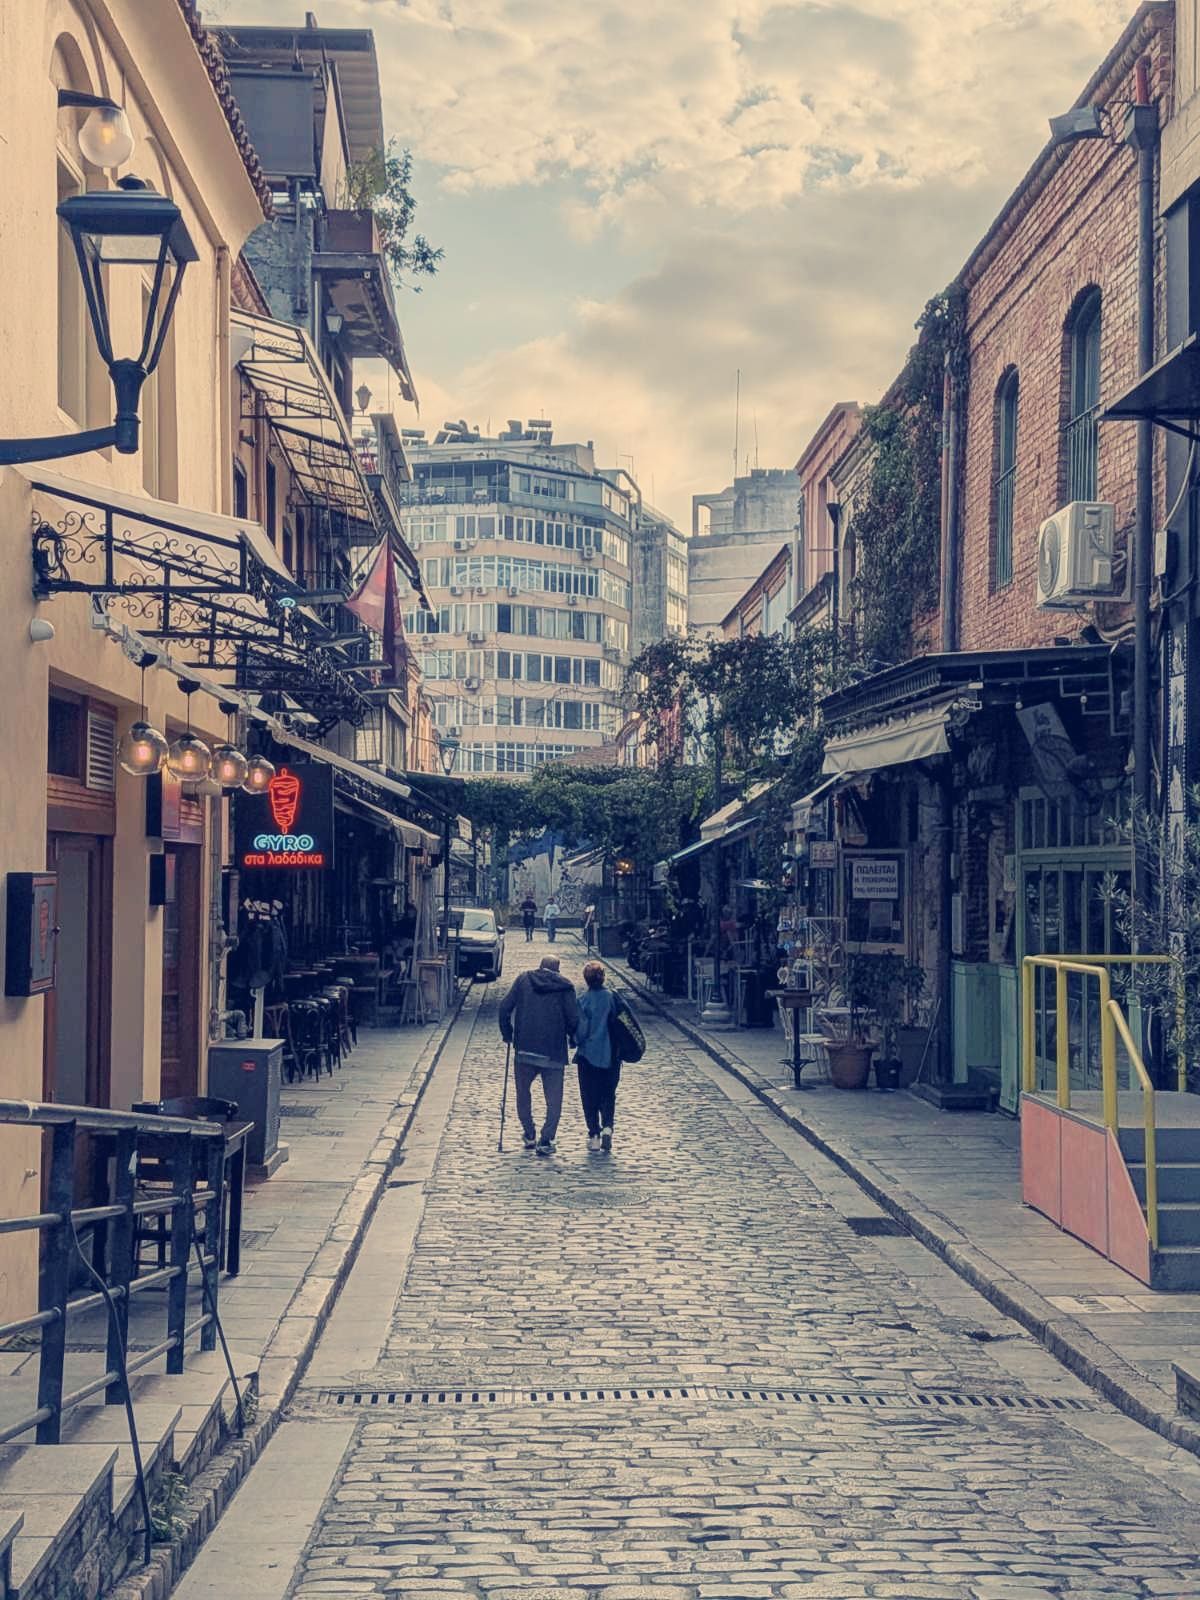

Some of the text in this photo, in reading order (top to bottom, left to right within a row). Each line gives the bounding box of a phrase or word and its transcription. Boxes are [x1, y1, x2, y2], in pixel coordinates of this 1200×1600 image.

[254, 834, 314, 851] GYRO
[244, 850, 323, 865] στα λαδάδικα
